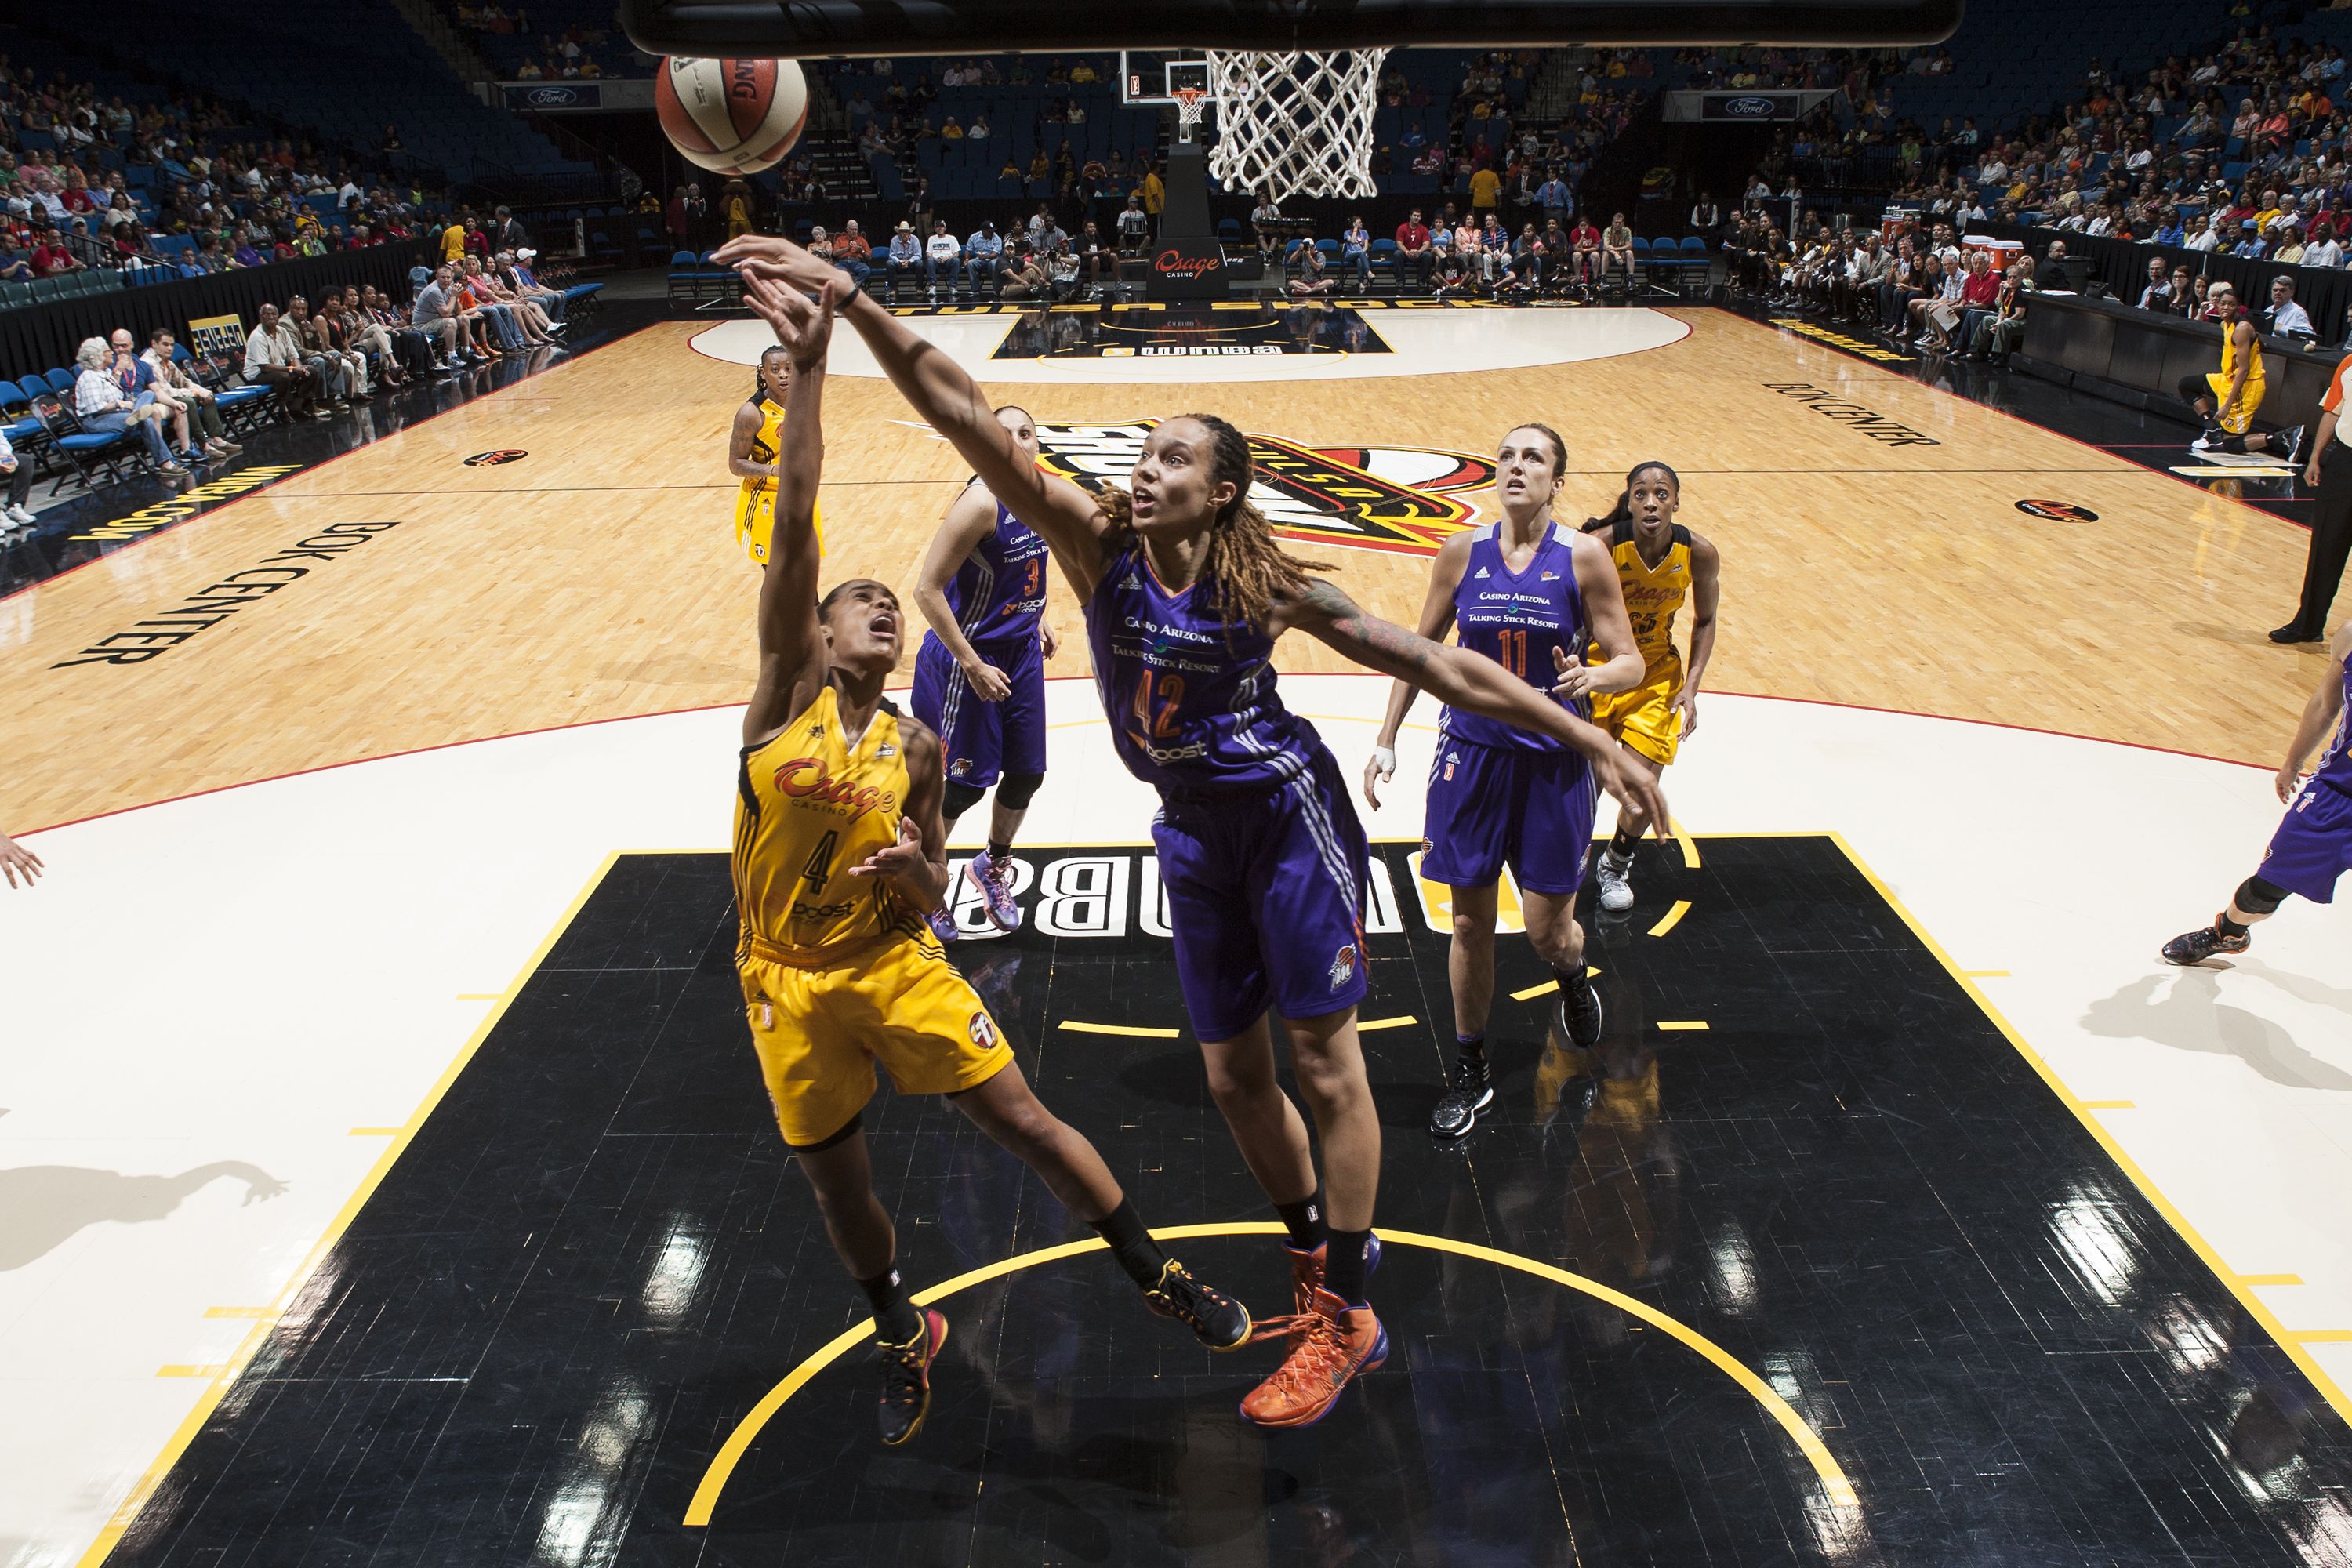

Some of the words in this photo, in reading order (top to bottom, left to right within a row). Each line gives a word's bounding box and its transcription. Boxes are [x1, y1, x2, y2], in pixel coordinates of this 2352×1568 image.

[538, 89, 567, 103] Ford
[1735, 100, 1765, 114] Ford
[1155, 250, 1220, 280] Osage
[885, 303, 1166, 316] TULSA
[1211, 300, 1510, 310] SHOCK
[1762, 383, 1847, 402] BOK
[1809, 404, 1941, 447] CENTER
[67, 464, 303, 540] WNBA.COM
[259, 521, 402, 564] BOK
[1025, 557, 1039, 597] 3
[1479, 592, 1511, 601] CASINO
[1512, 593, 1551, 605] ARIZONA
[48, 567, 310, 670] CENTER
[1468, 614, 1501, 622] TALKING
[1503, 615, 1526, 624] STICK
[1527, 616, 1559, 630] RESORT
[1160, 624, 1214, 644] ARIZONA
[1148, 653, 1176, 669] STICK
[1178, 659, 1221, 674] RESORT
[1498, 629, 1526, 678] 11
[1134, 669, 1185, 739] 42
[1145, 740, 1208, 760] boost
[774, 757, 896, 825] Osage
[791, 798, 848, 817] CASINO
[802, 829, 839, 896] 4
[792, 900, 855, 918] boost
